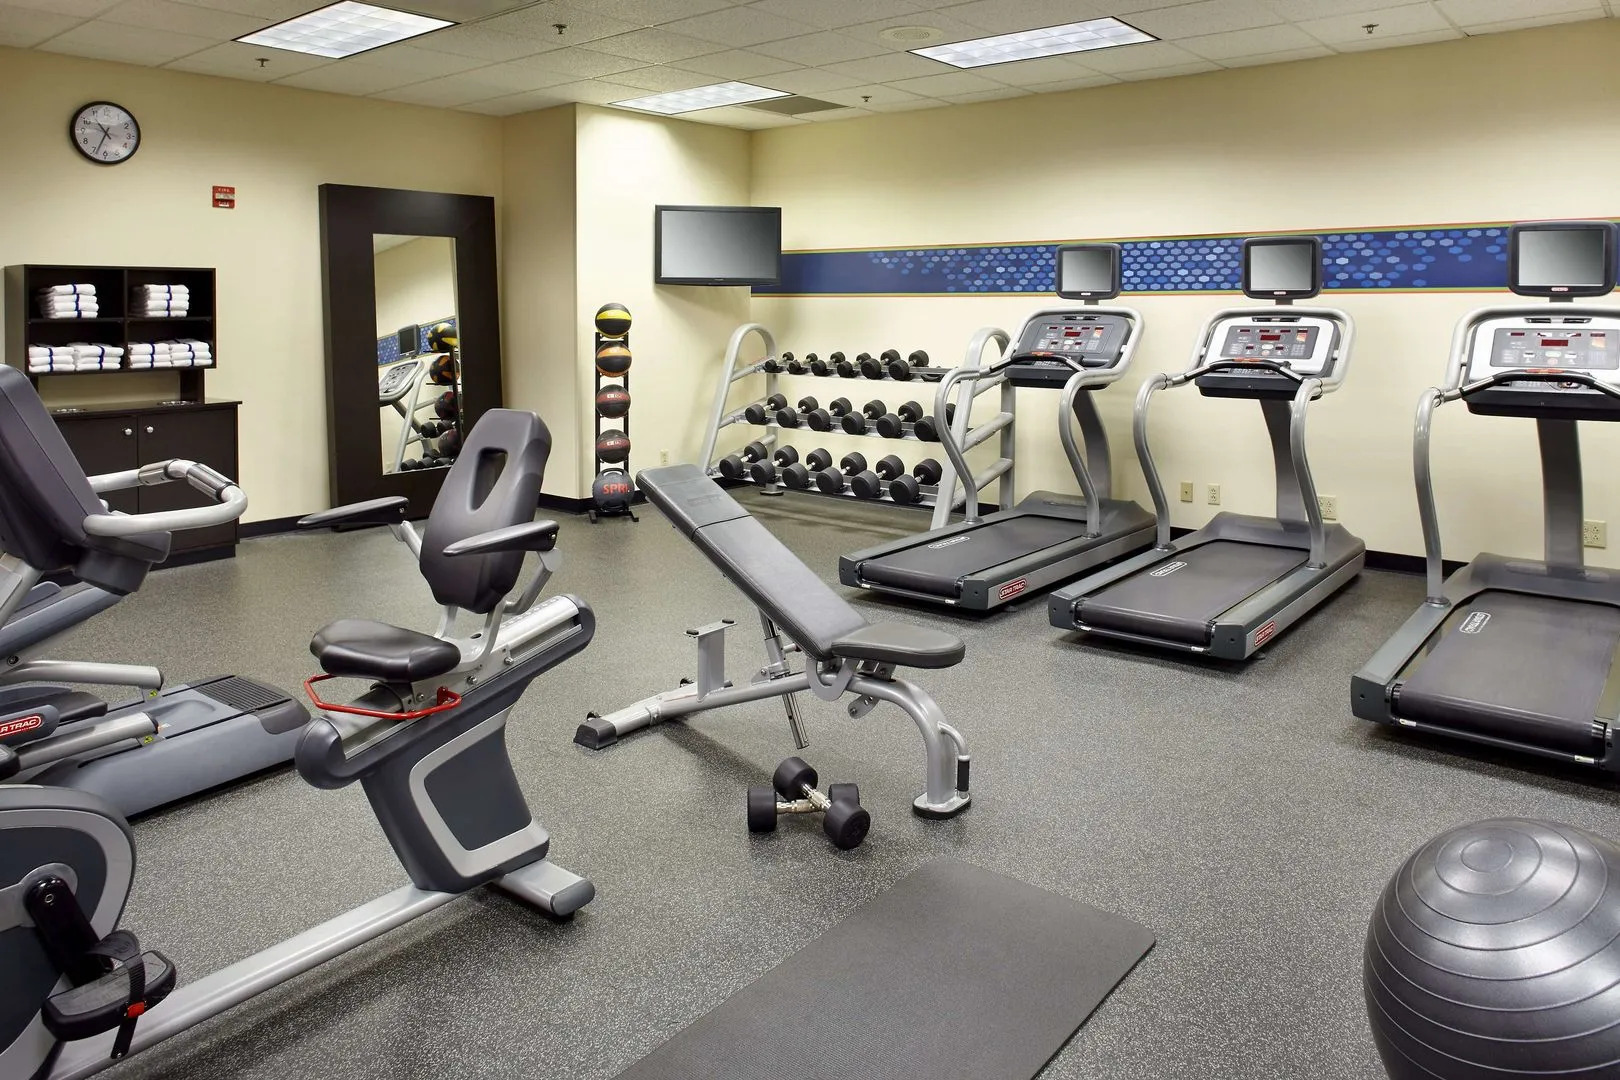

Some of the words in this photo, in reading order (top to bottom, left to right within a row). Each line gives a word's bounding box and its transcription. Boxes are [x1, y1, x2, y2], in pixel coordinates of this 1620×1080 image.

[124, 122, 129, 130] 2
[126, 132, 131, 140] 3
[82, 137, 88, 145] 8
[11, 719, 37, 730] TRAC
